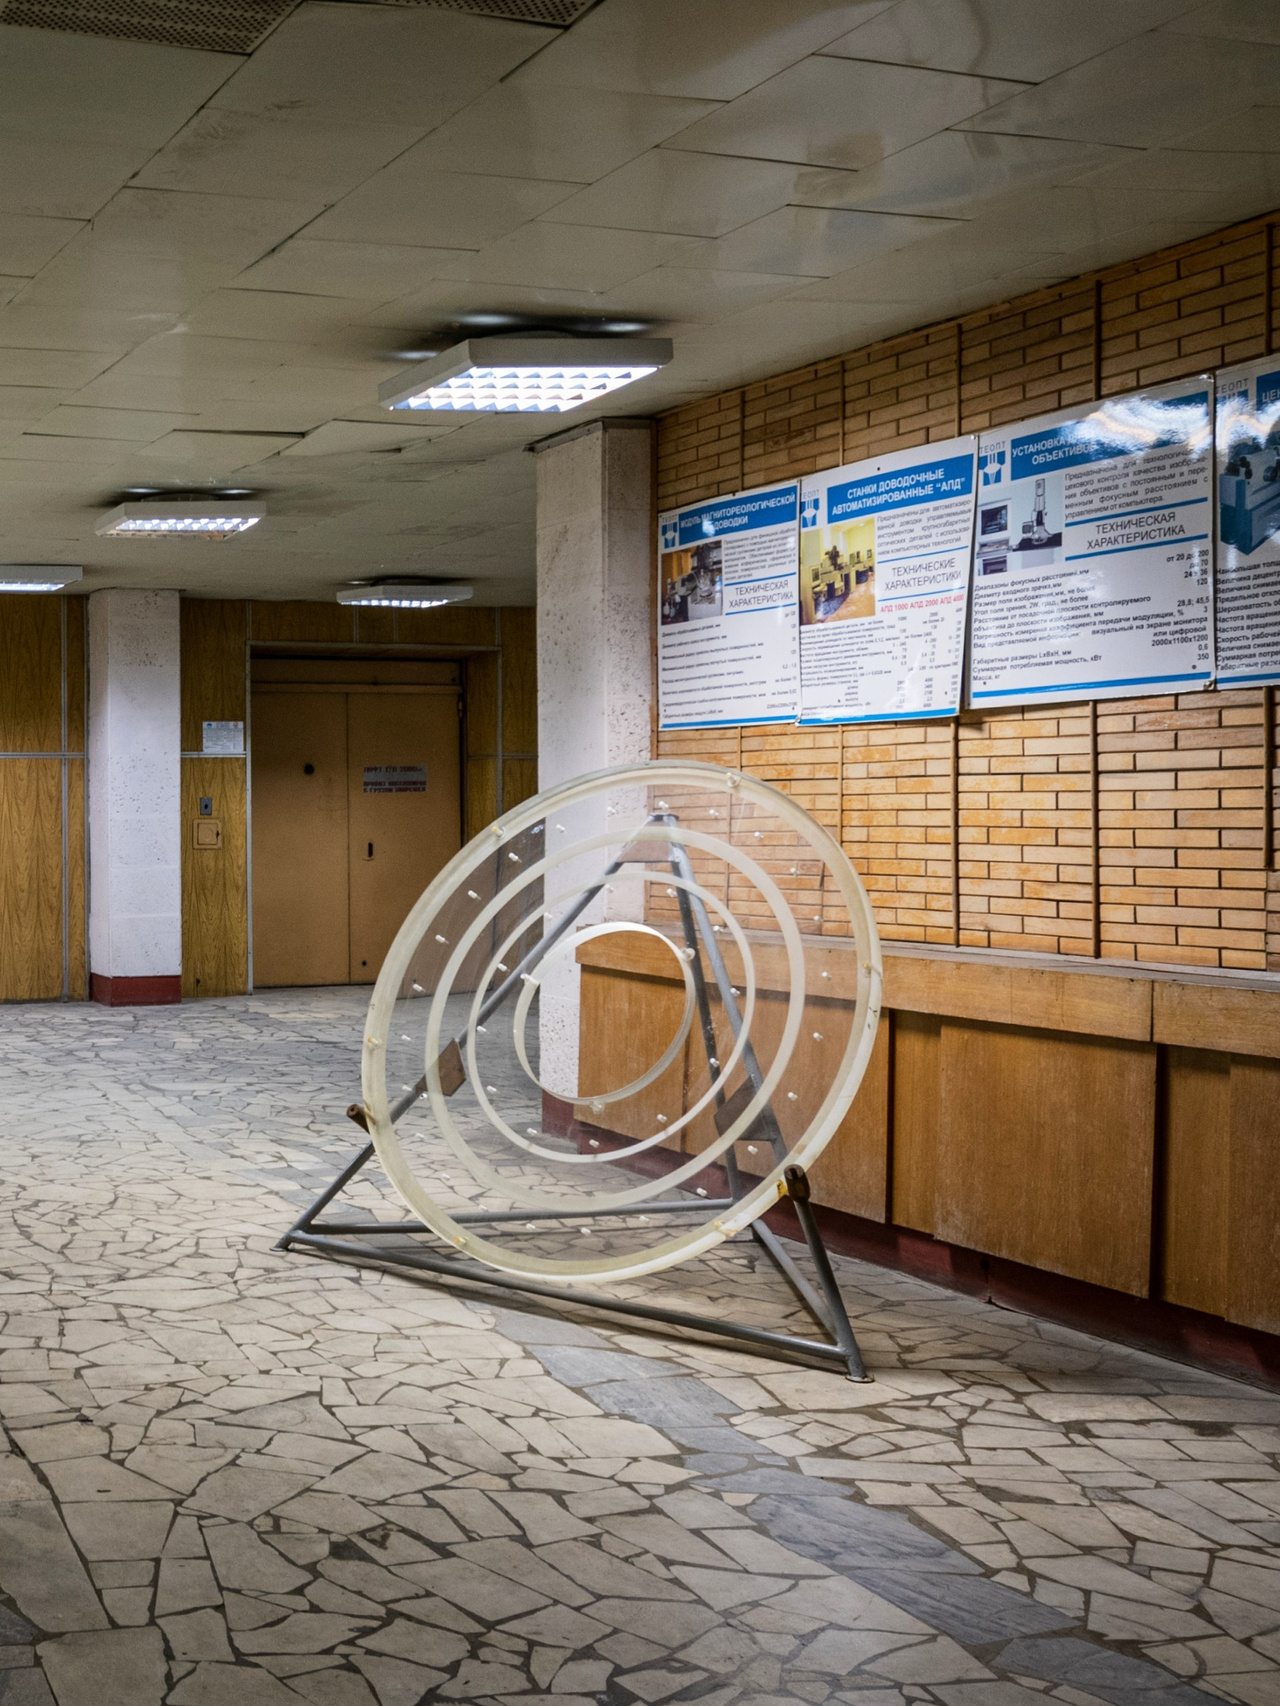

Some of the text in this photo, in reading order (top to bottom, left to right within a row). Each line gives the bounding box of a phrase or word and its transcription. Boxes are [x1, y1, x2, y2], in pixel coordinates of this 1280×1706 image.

[1215, 376, 1248, 396] ТЕОПТ
[1262, 387, 1280, 403] ЦЕ
[979, 440, 1005, 454] ТЕОПТ
[1012, 435, 1065, 457] УСТАНОВКА
[1064, 459, 1136, 482] Предназначена для
[1065, 463, 1165, 491] цехового контроля качества
[847, 468, 944, 499] СТАНКИ ДОВОДОЧНЫЕ
[1064, 491, 1076, 500] ния
[1080, 483, 1118, 497] объективов
[1122, 481, 1126, 489] с
[1130, 471, 1175, 487] постоянным
[1179, 469, 1183, 477] и
[1064, 475, 1208, 510] менным фокусным расстоянием с
[832, 483, 933, 514] АВТОМАТИЗИРОВАННЫЕ
[1064, 504, 1108, 520] управлением
[1110, 503, 1117, 511] от
[1095, 511, 1175, 535] ТЕХНИЧЕСКАЯ
[1086, 524, 1185, 550] ХАРАКТЕРИСТИКА
[891, 558, 955, 577] ТЕХНИЧЕСКИЕ
[974, 580, 1008, 591] Диапазоны
[1010, 575, 1039, 586] фокусных
[1166, 554, 1174, 562] от
[1176, 553, 1184, 561] 20
[1197, 549, 1208, 558] 200
[1184, 570, 1192, 578] 24
[1200, 568, 1207, 576] 36
[735, 578, 788, 596] ТЕХНИЧЕСКАЯ
[884, 570, 961, 590] ХАРАКТЕРИСТИКИ
[1196, 577, 1207, 585] 120
[1216, 583, 1250, 594] Величина
[729, 590, 792, 608] ХАРАКТЕРИСТИКА
[974, 590, 1000, 599] Диаметр
[1002, 585, 1029, 595] входного
[1216, 591, 1259, 604] Предельное
[880, 594, 964, 612] АПД 1000 АПД 2000 АПД 4000
[974, 613, 1008, 624] Расстояние
[1010, 612, 1016, 620] от
[1090, 595, 1150, 609] контролируемого
[1016, 617, 1047, 627] плоскости
[1093, 610, 1103, 618] мм
[1177, 598, 1193, 607] 28,8;
[1195, 596, 1209, 605] 45,5
[1091, 624, 1133, 635] визуальный
[1146, 620, 1171, 629] экране
[1173, 616, 1207, 626] монитора
[1097, 616, 1130, 626] передачи
[1203, 606, 1207, 614] 3
[1153, 625, 1206, 637] или цифровой
[1217, 633, 1249, 644] Скорость
[1217, 642, 1251, 652] Величина
[972, 664, 1006, 673] Суммарная
[1009, 660, 1052, 670] потребляемая
[1198, 643, 1208, 651] 0,6
[973, 655, 1008, 665] Габаритные
[1010, 652, 1037, 661] размеры
[1217, 652, 1256, 662] Суммарная
